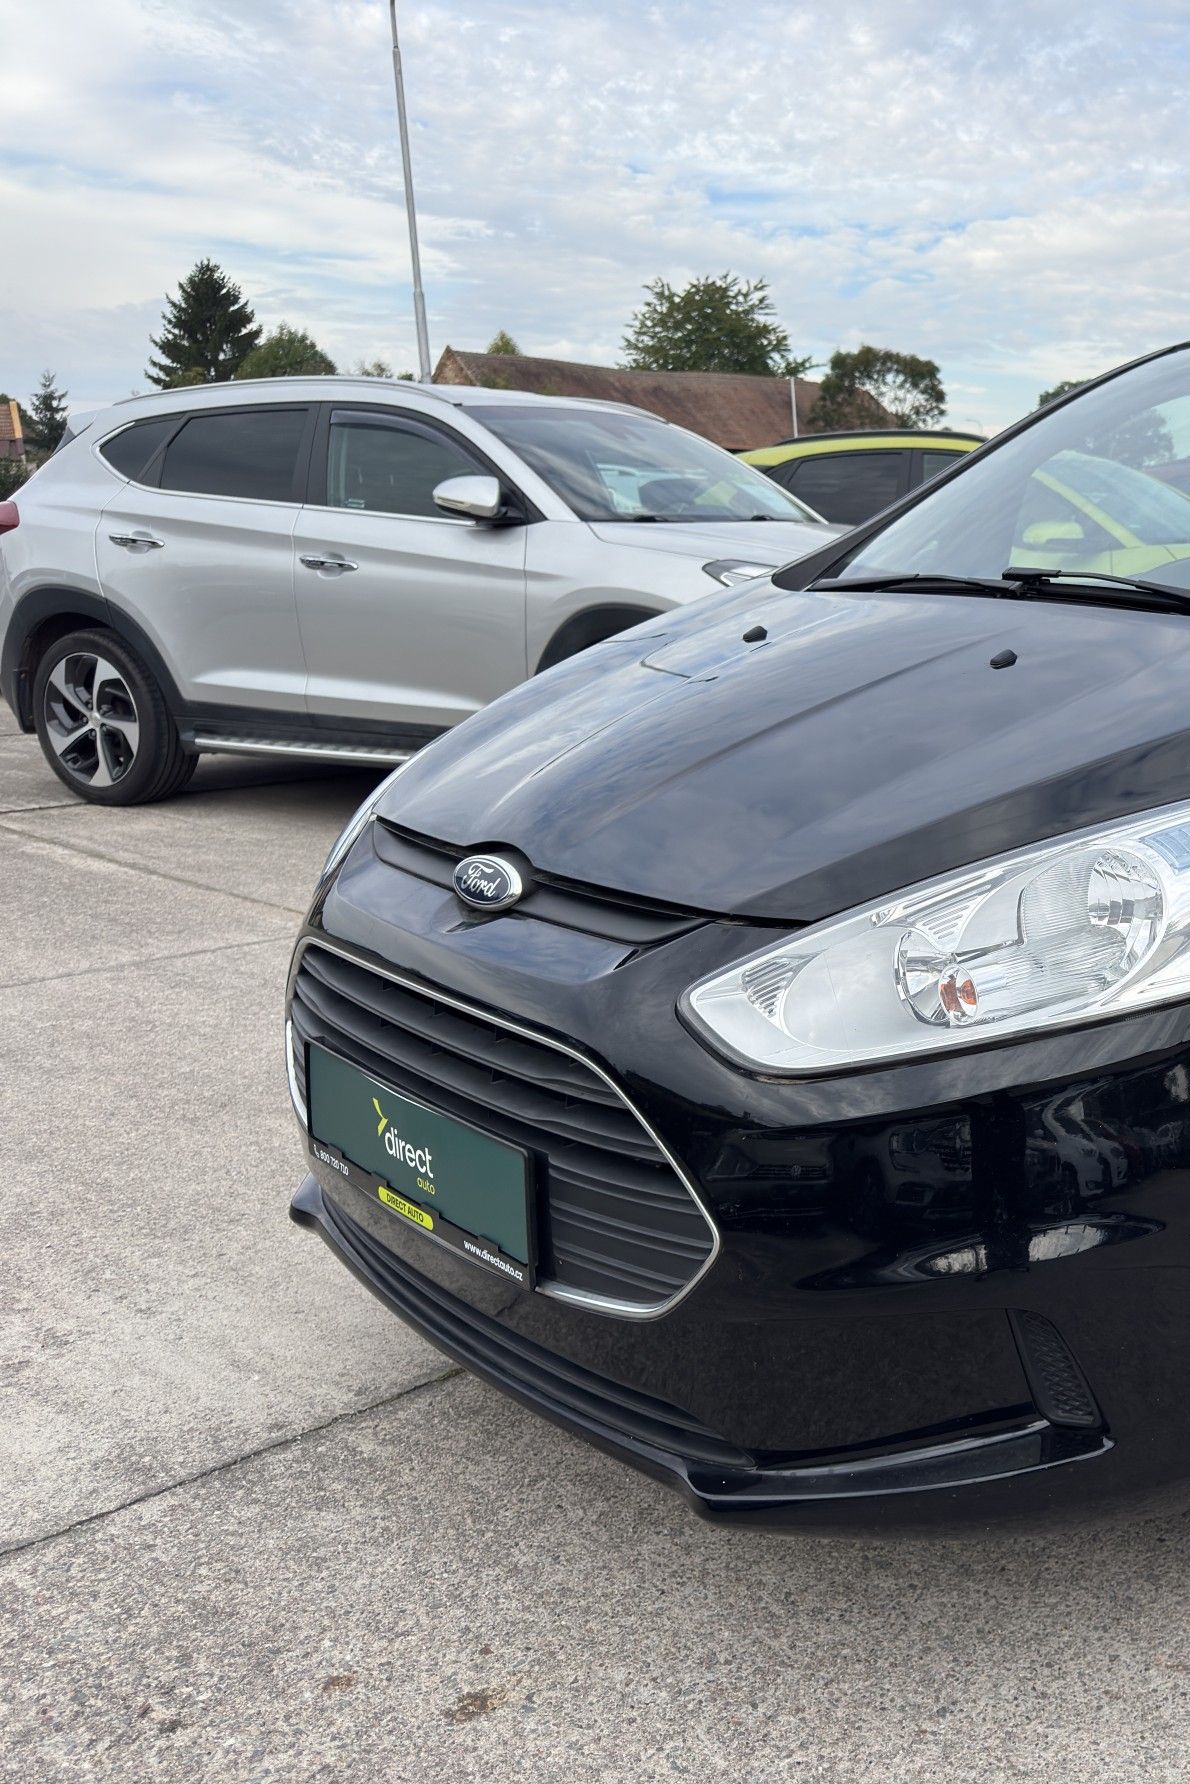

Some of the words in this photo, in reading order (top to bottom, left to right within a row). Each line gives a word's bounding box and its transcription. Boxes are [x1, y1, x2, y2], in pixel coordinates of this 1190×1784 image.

[461, 863, 501, 898] Ford
[385, 1127, 434, 1178] direct
[416, 1176, 436, 1195] auto
[386, 1193, 407, 1214] DIRECT
[407, 1203, 424, 1223] AUTO
[463, 1239, 523, 1281] www.directauto.cz
